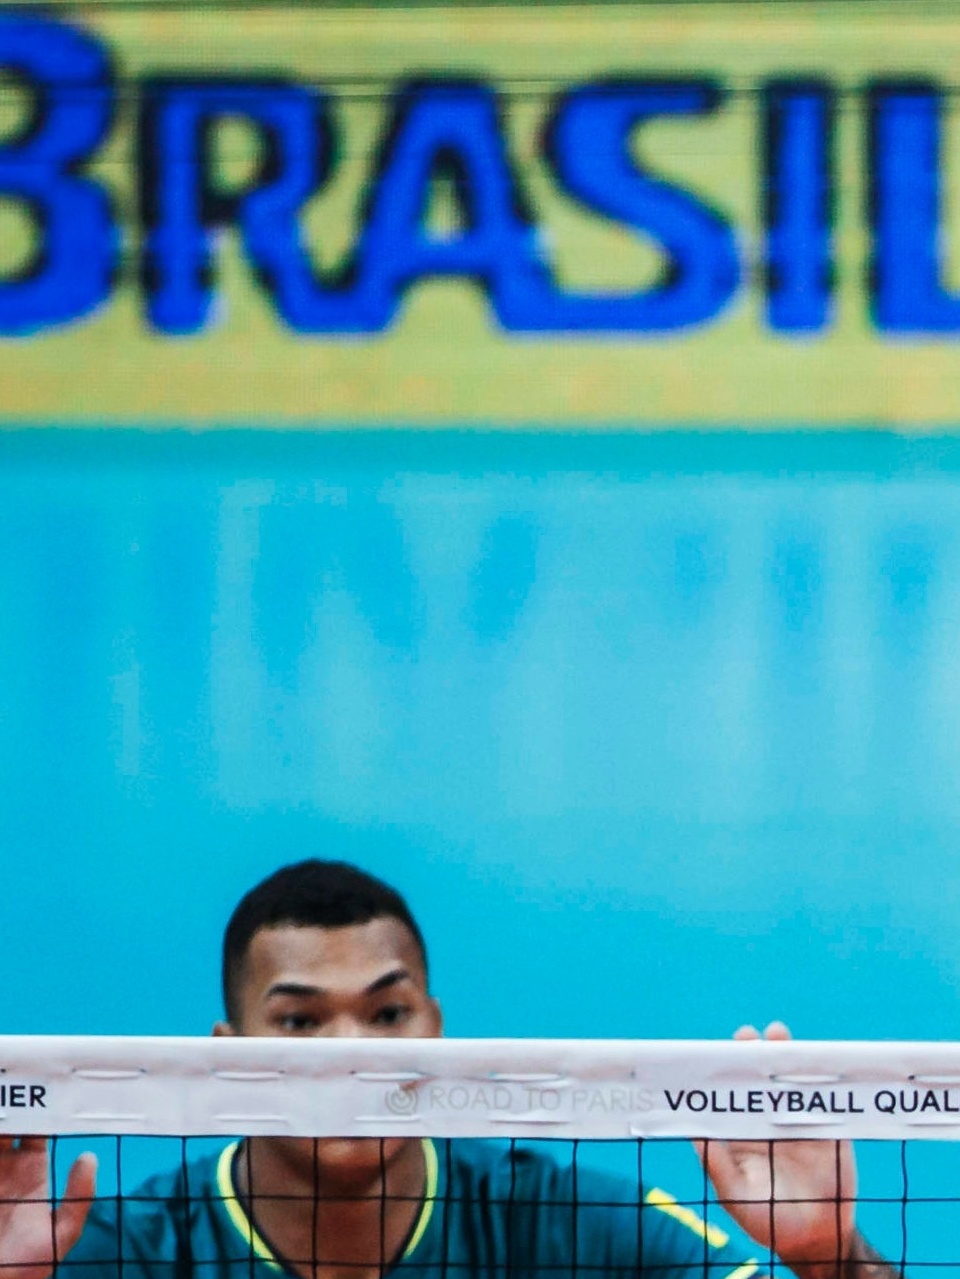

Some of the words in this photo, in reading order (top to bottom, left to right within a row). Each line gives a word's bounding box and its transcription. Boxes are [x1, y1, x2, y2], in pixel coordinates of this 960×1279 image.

[429, 1087, 512, 1111] ROAD
[523, 1088, 562, 1111] TO
[572, 1090, 654, 1113] PARIS
[664, 1089, 864, 1113] VOLLEYBALL
